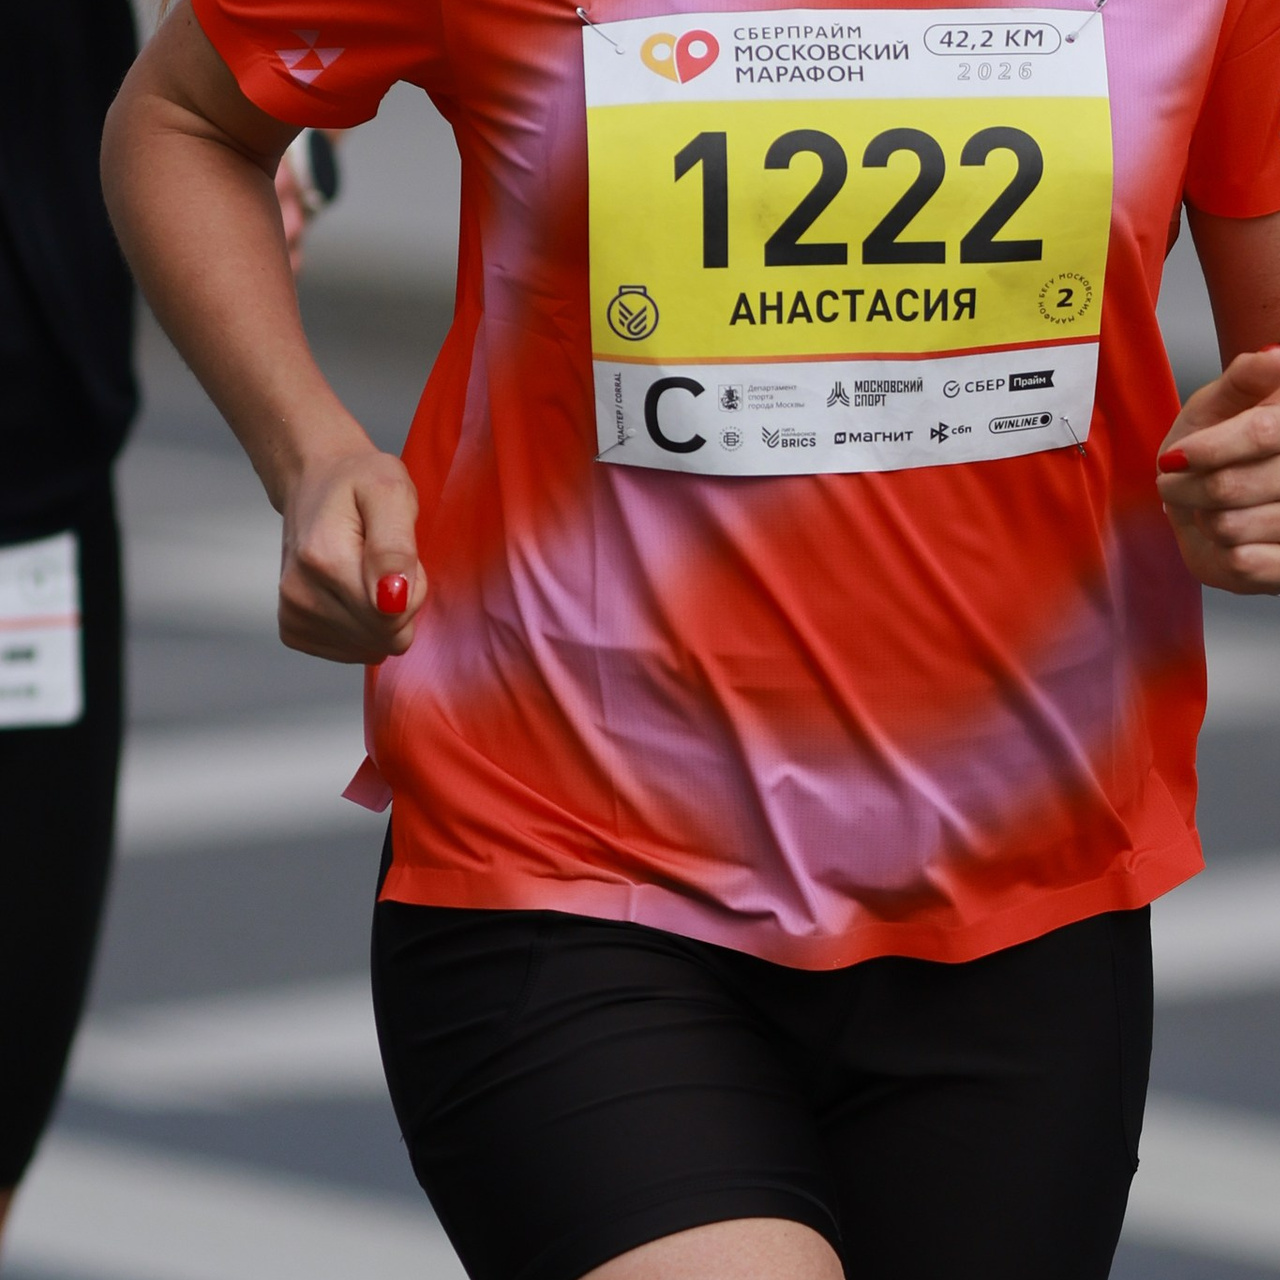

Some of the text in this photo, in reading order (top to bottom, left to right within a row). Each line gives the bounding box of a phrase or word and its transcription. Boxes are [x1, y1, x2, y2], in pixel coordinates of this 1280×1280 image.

[733, 23, 862, 41] СБЕРПРАЙМ
[939, 29, 1044, 51] 42,2 КМ
[734, 41, 910, 62] МОСКОВСКИЙ
[735, 65, 864, 83] МАРАФОН
[957, 62, 1032, 81] 2026
[674, 125, 1044, 269] 1222
[1056, 288, 1074, 308] 2
[1058, 272, 1093, 316] МОСКОВСКИЙ
[729, 288, 977, 326] АНАСТАСИЯ
[1038, 301, 1075, 324] МАРАФОН
[614, 372, 623, 403] CORRAL
[748, 384, 797, 393] Департамент
[854, 377, 923, 393] МОСКОВСКИЙ
[964, 375, 1046, 393] СБЕР Прайм
[775, 401, 805, 409] Москвы
[854, 394, 887, 408] СПОРТ
[616, 409, 626, 446] КЛАСТЕР
[951, 425, 972, 435] сбп
[994, 417, 1039, 430] WINLINE
[781, 437, 816, 448] BRICS
[849, 431, 914, 443] магнит
